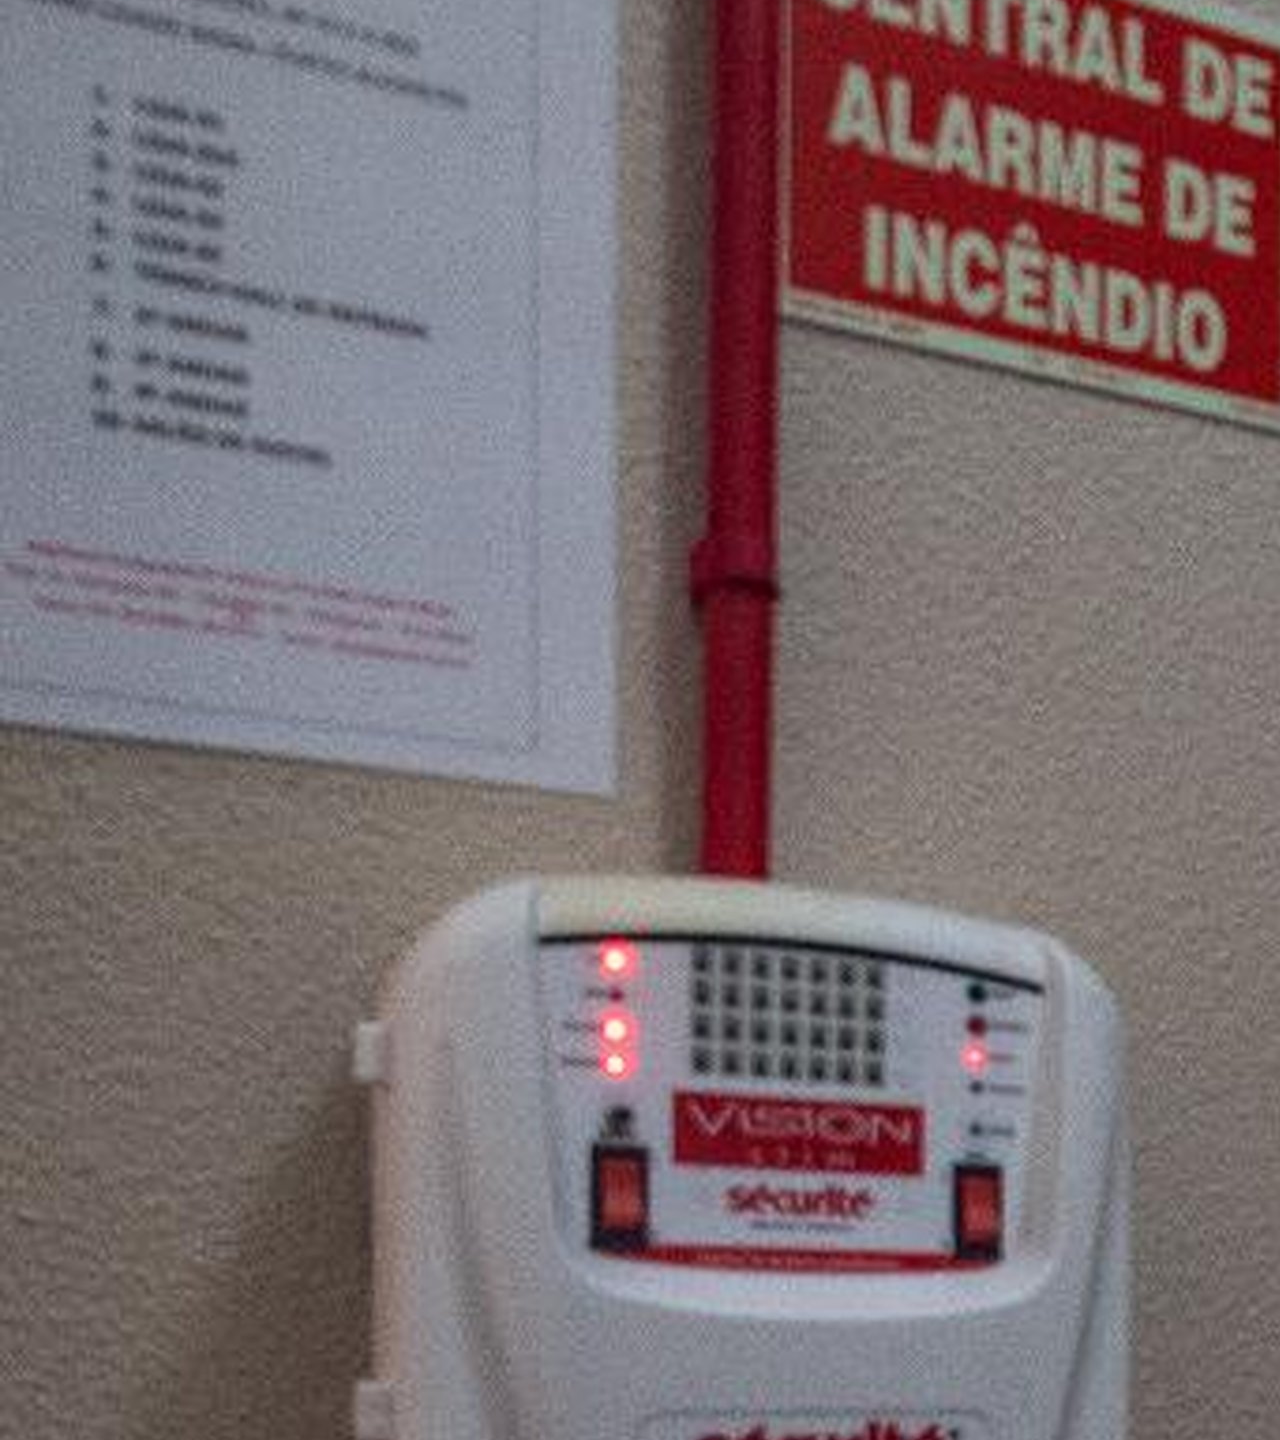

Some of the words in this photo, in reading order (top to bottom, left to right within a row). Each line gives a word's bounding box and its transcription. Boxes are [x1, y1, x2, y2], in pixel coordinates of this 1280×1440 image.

[1182, 39, 1276, 136] DE
[827, 65, 1144, 226] ALARME
[1165, 159, 1257, 256] DE
[862, 207, 1227, 371] INCÊNDIO
[688, 1103, 914, 1146] VISION
